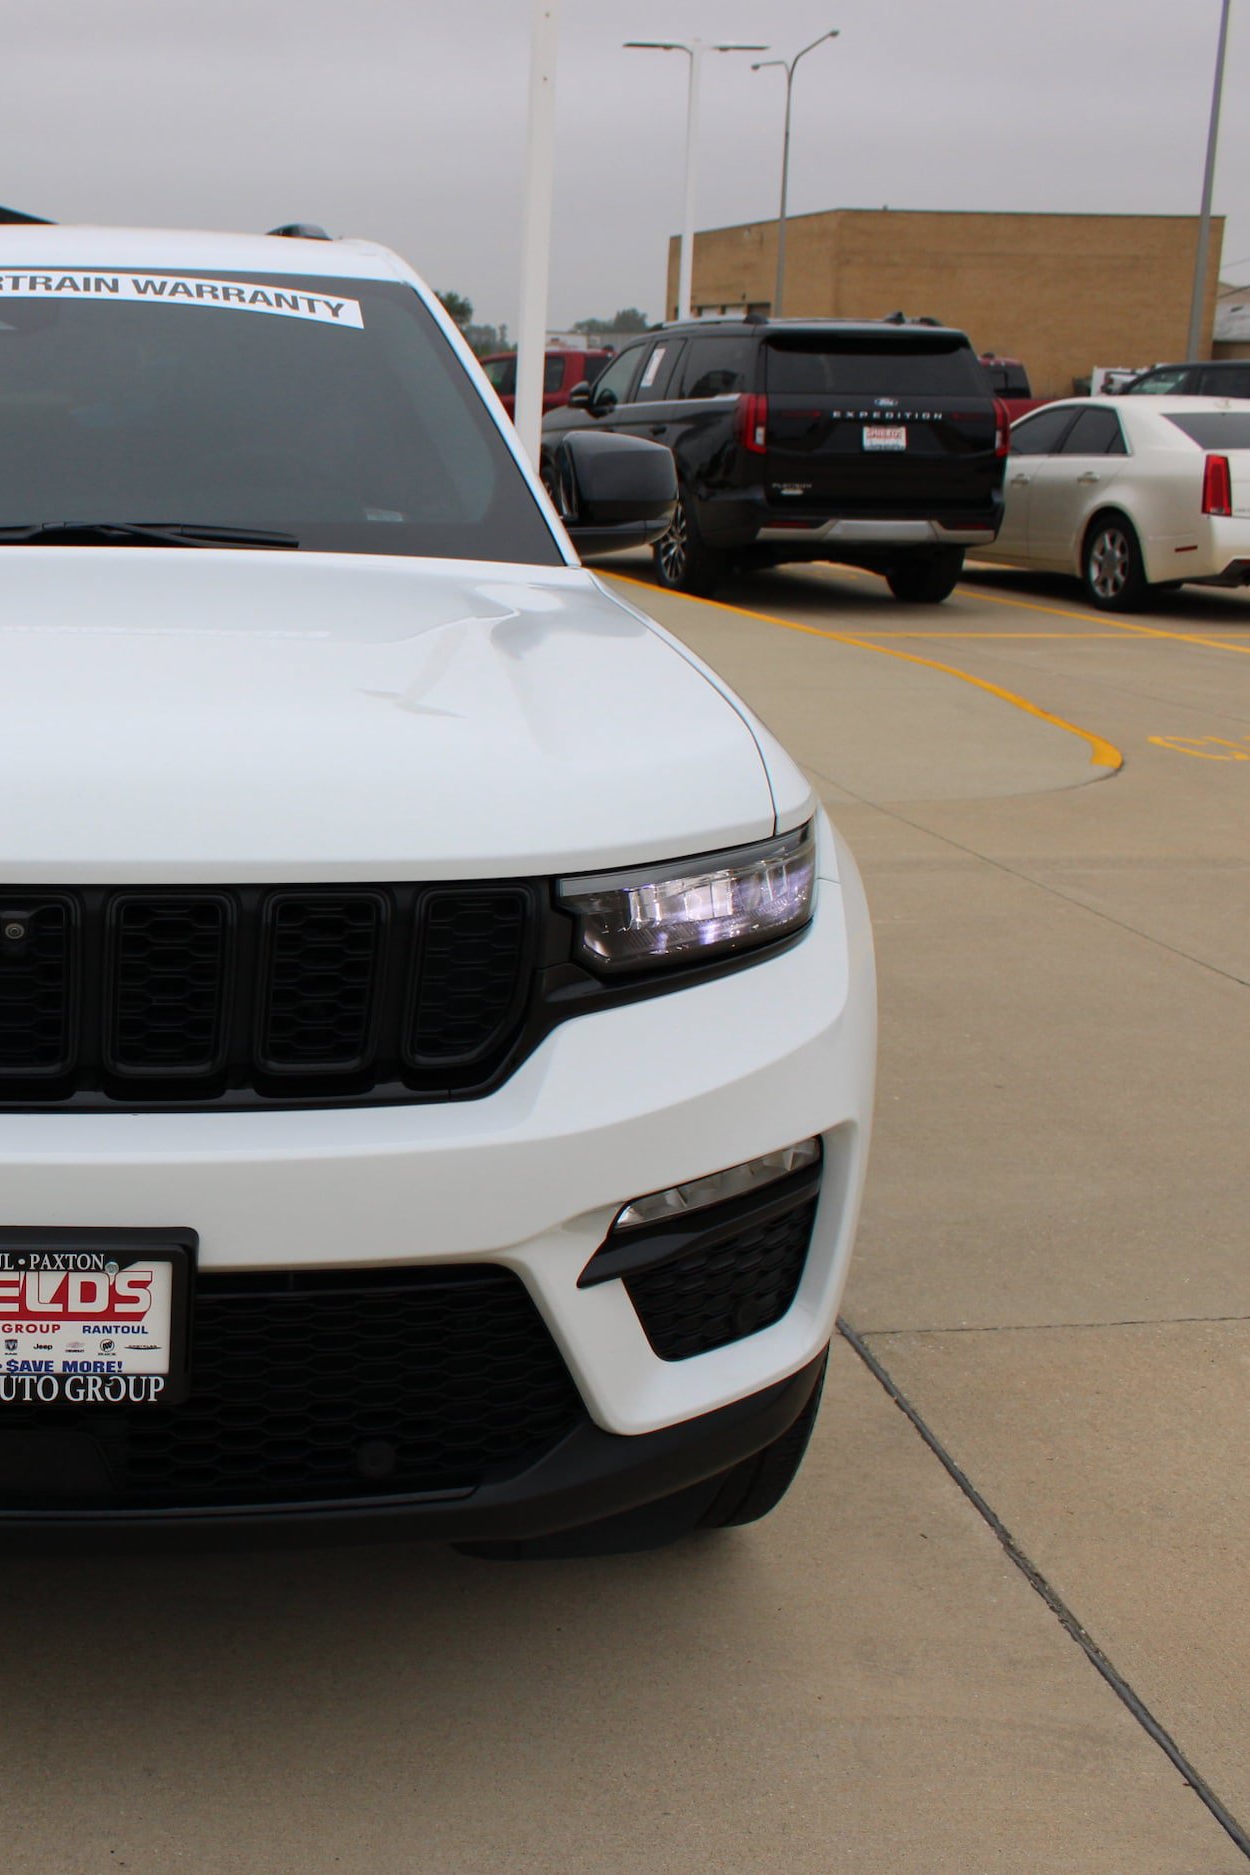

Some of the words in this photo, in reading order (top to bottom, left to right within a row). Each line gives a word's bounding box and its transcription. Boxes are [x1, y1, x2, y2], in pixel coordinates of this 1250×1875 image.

[132, 279, 344, 317] WARRANTY
[832, 411, 943, 419] EXPEDITION
[30, 1253, 104, 1271] PAXTON
[2, 1323, 61, 1334] GROUP
[82, 1325, 149, 1335] RANTOUL
[6, 1359, 54, 1373] $AVE
[62, 1360, 123, 1373] MORE!
[64, 1375, 165, 1402] GROUP
